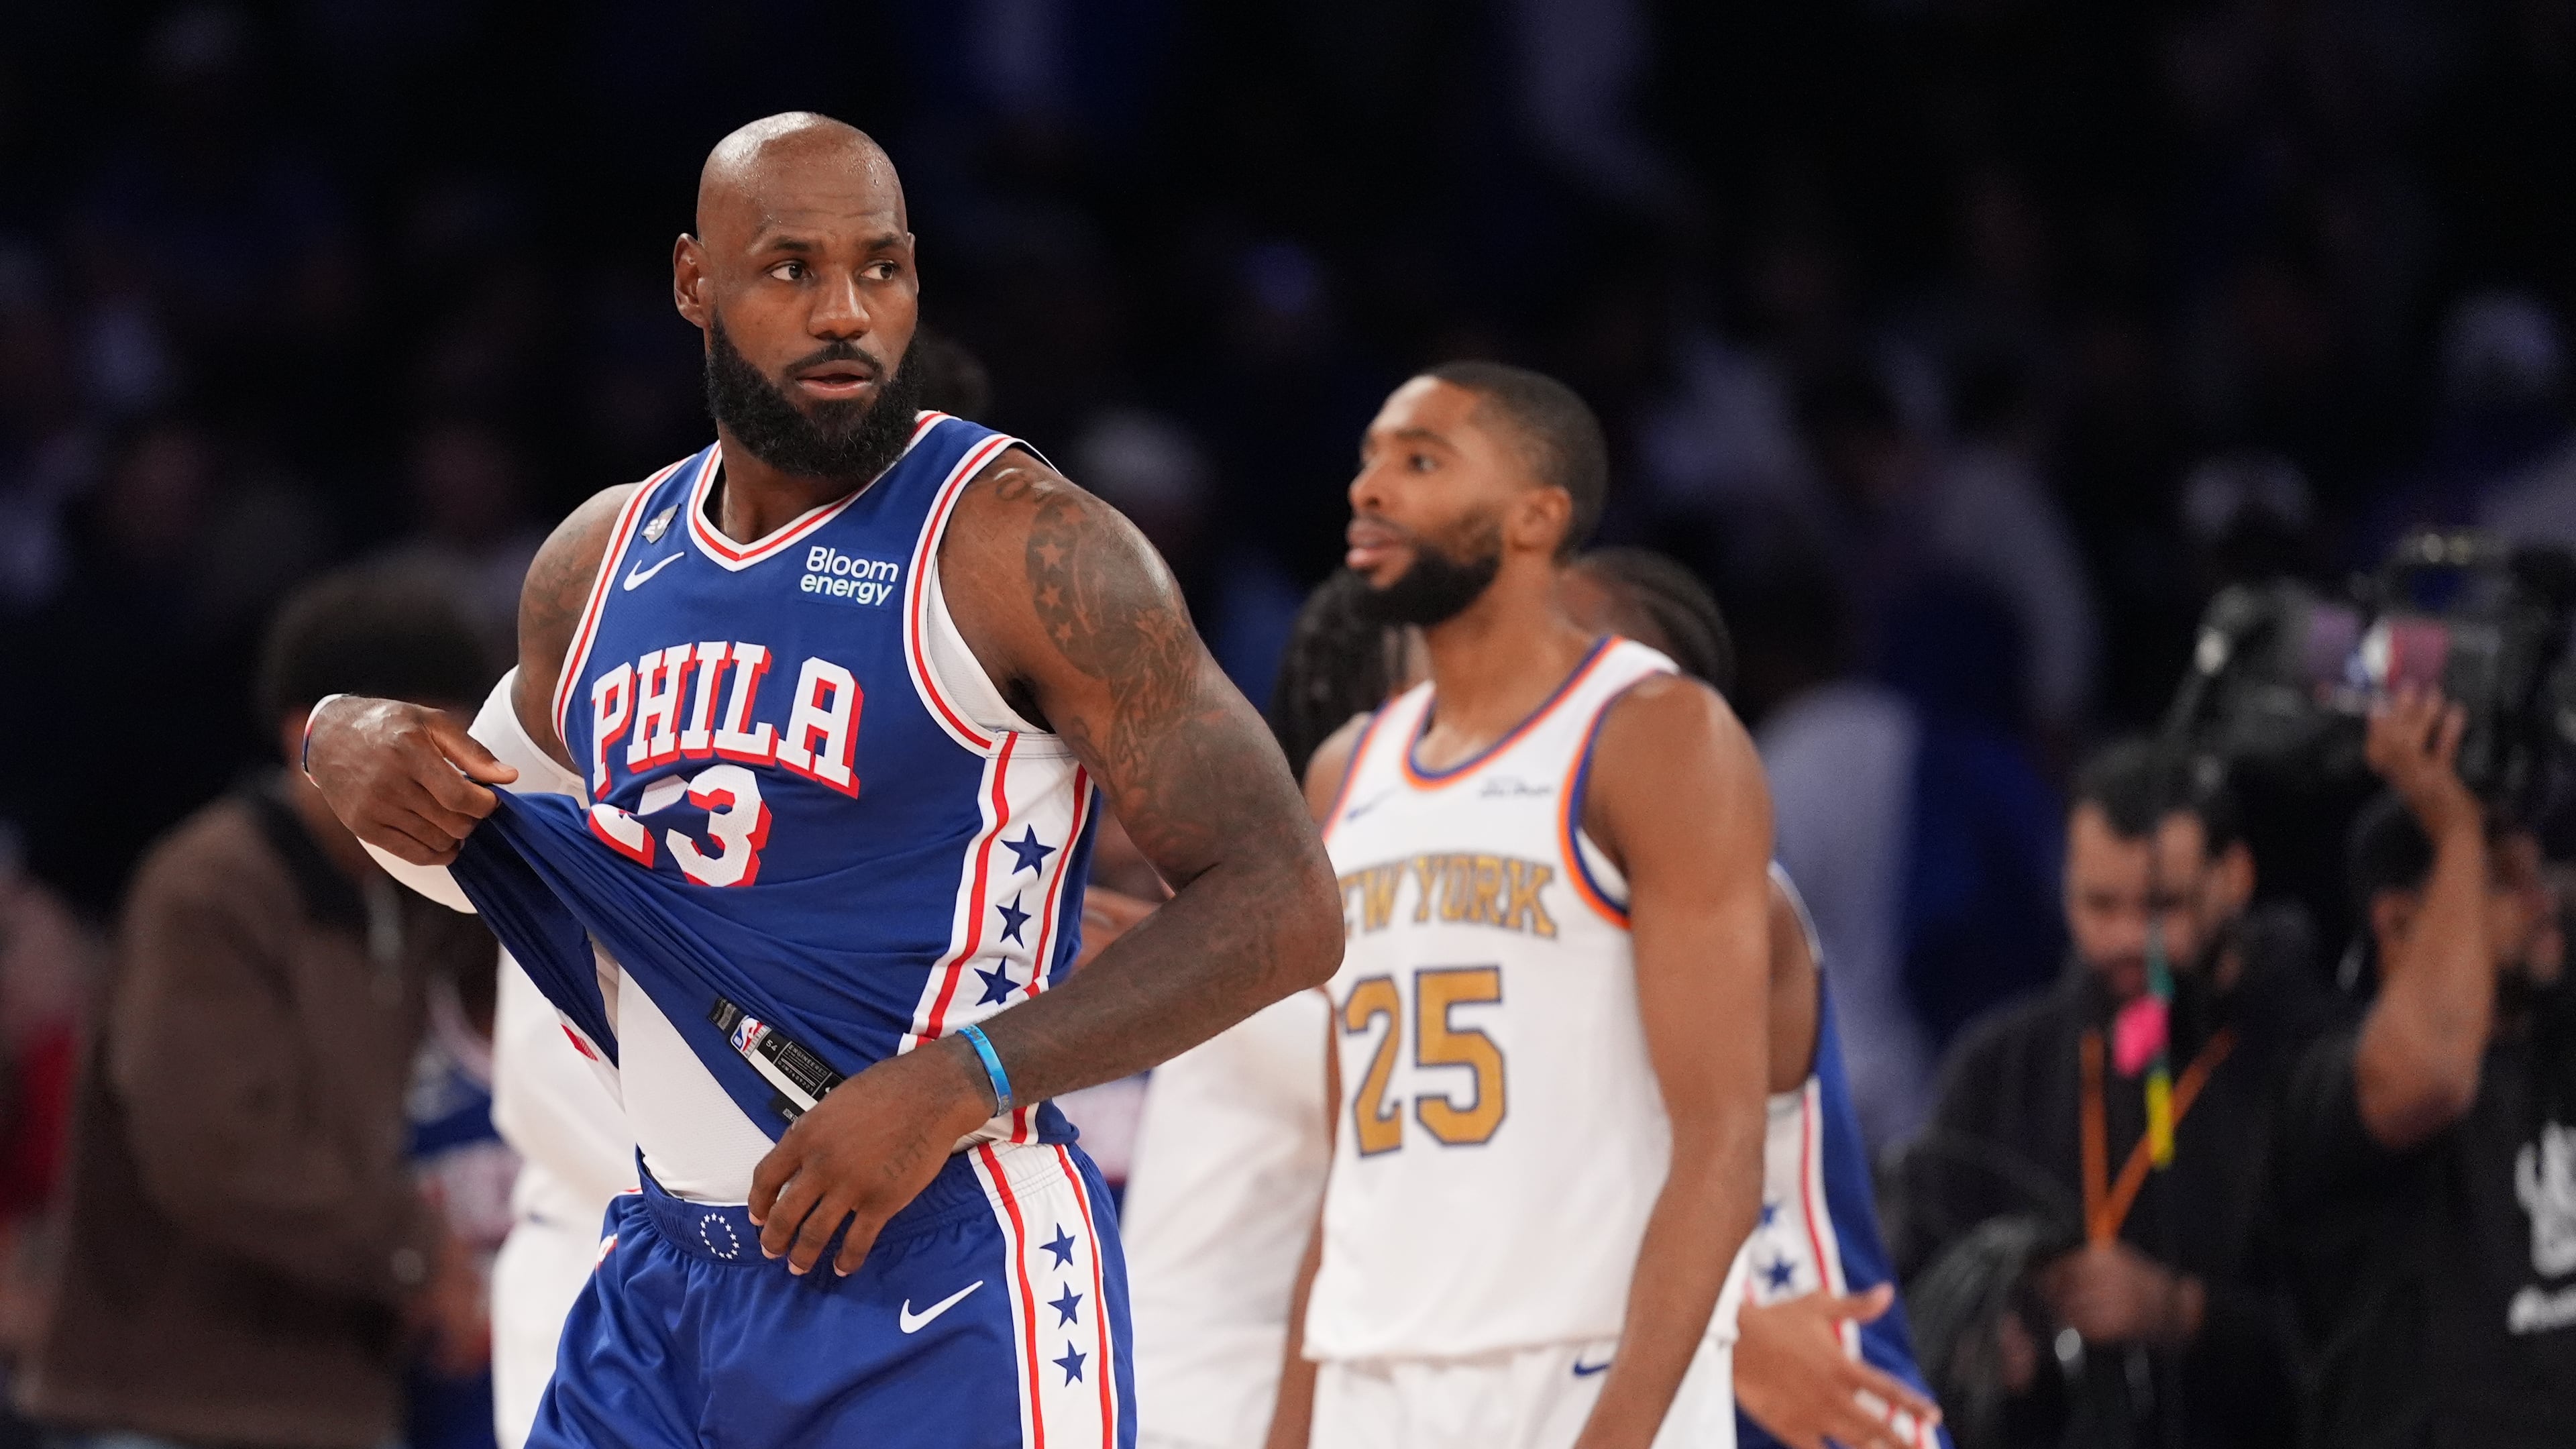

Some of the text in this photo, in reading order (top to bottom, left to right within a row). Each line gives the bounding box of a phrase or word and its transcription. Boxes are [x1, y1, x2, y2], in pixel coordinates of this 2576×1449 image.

[800, 573, 894, 606] energy
[806, 545, 900, 582] Bloom
[591, 641, 864, 801] PHILA
[1338, 852, 1558, 941] EW YORK
[788, 1044, 828, 1076] ENGINEERED
[1342, 964, 1507, 1159] 25
